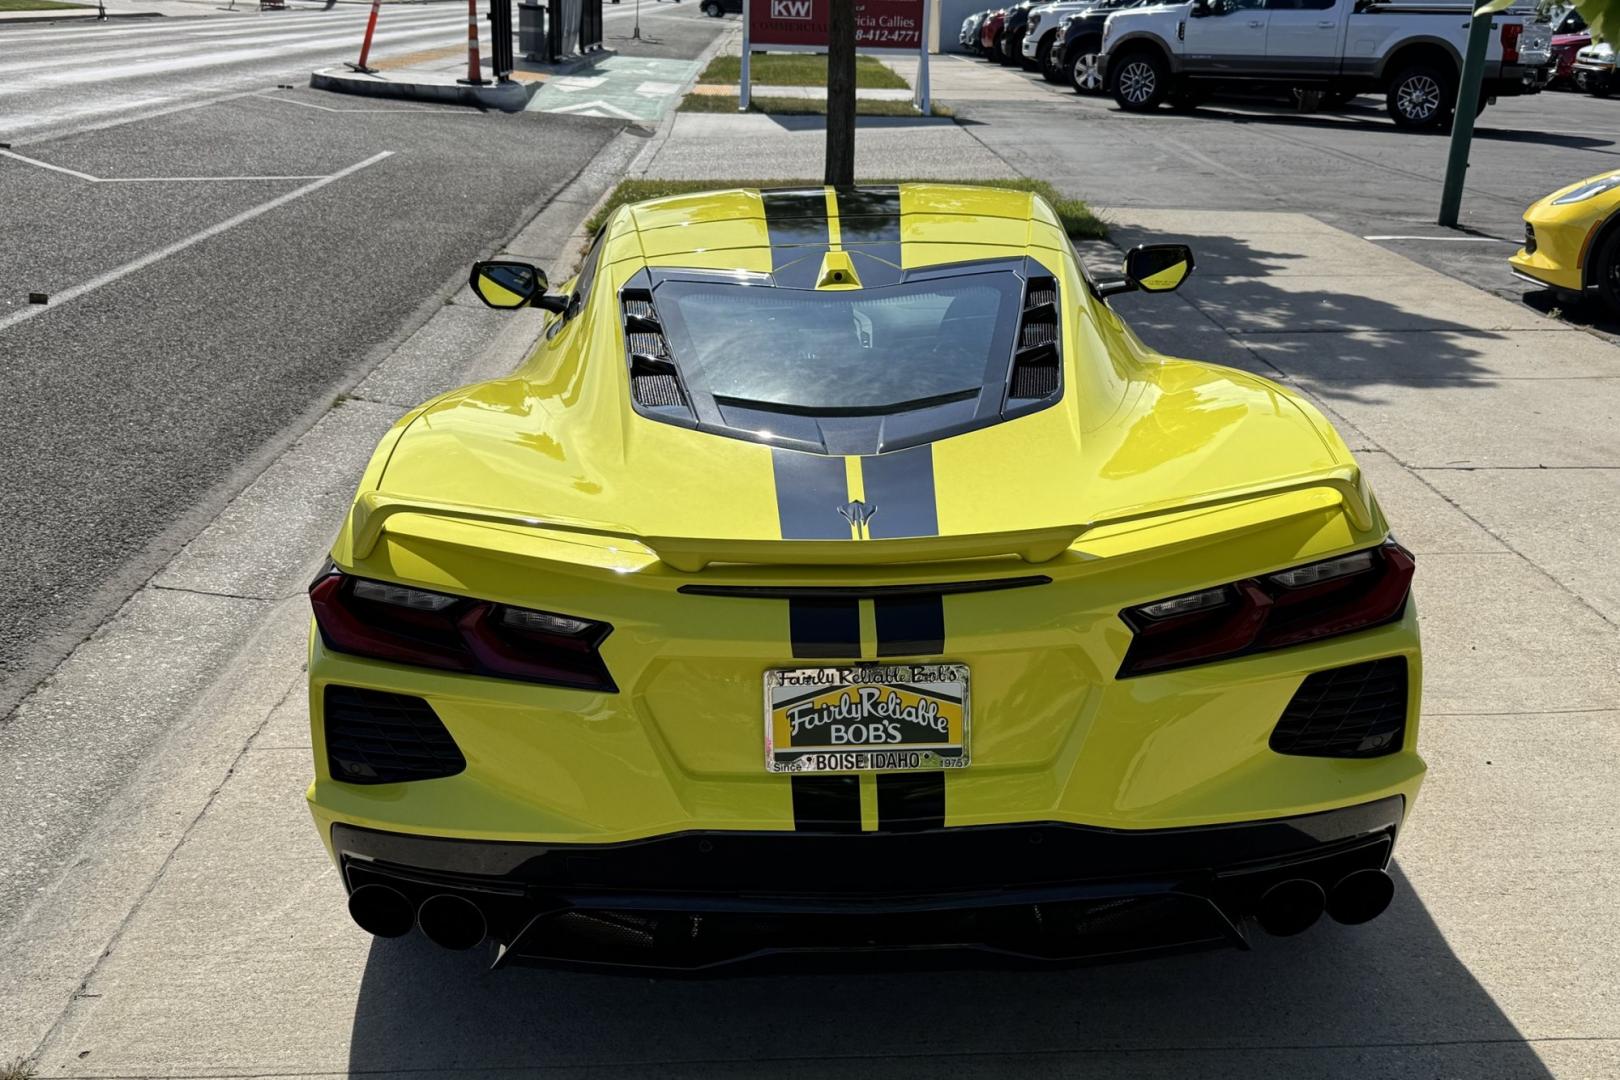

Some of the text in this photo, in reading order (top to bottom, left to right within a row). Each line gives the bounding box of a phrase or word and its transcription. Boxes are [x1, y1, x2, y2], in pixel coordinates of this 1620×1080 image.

[773, 0, 810, 16] KW
[879, 16, 915, 28] Callies
[855, 29, 920, 42] 8-412-4771
[778, 665, 957, 686] Fairly Reliable Bob's
[787, 687, 948, 737] Fairly Reliable
[830, 720, 902, 744] BOB'S
[774, 762, 802, 772] Since
[816, 752, 920, 770] BOISE IDAHO
